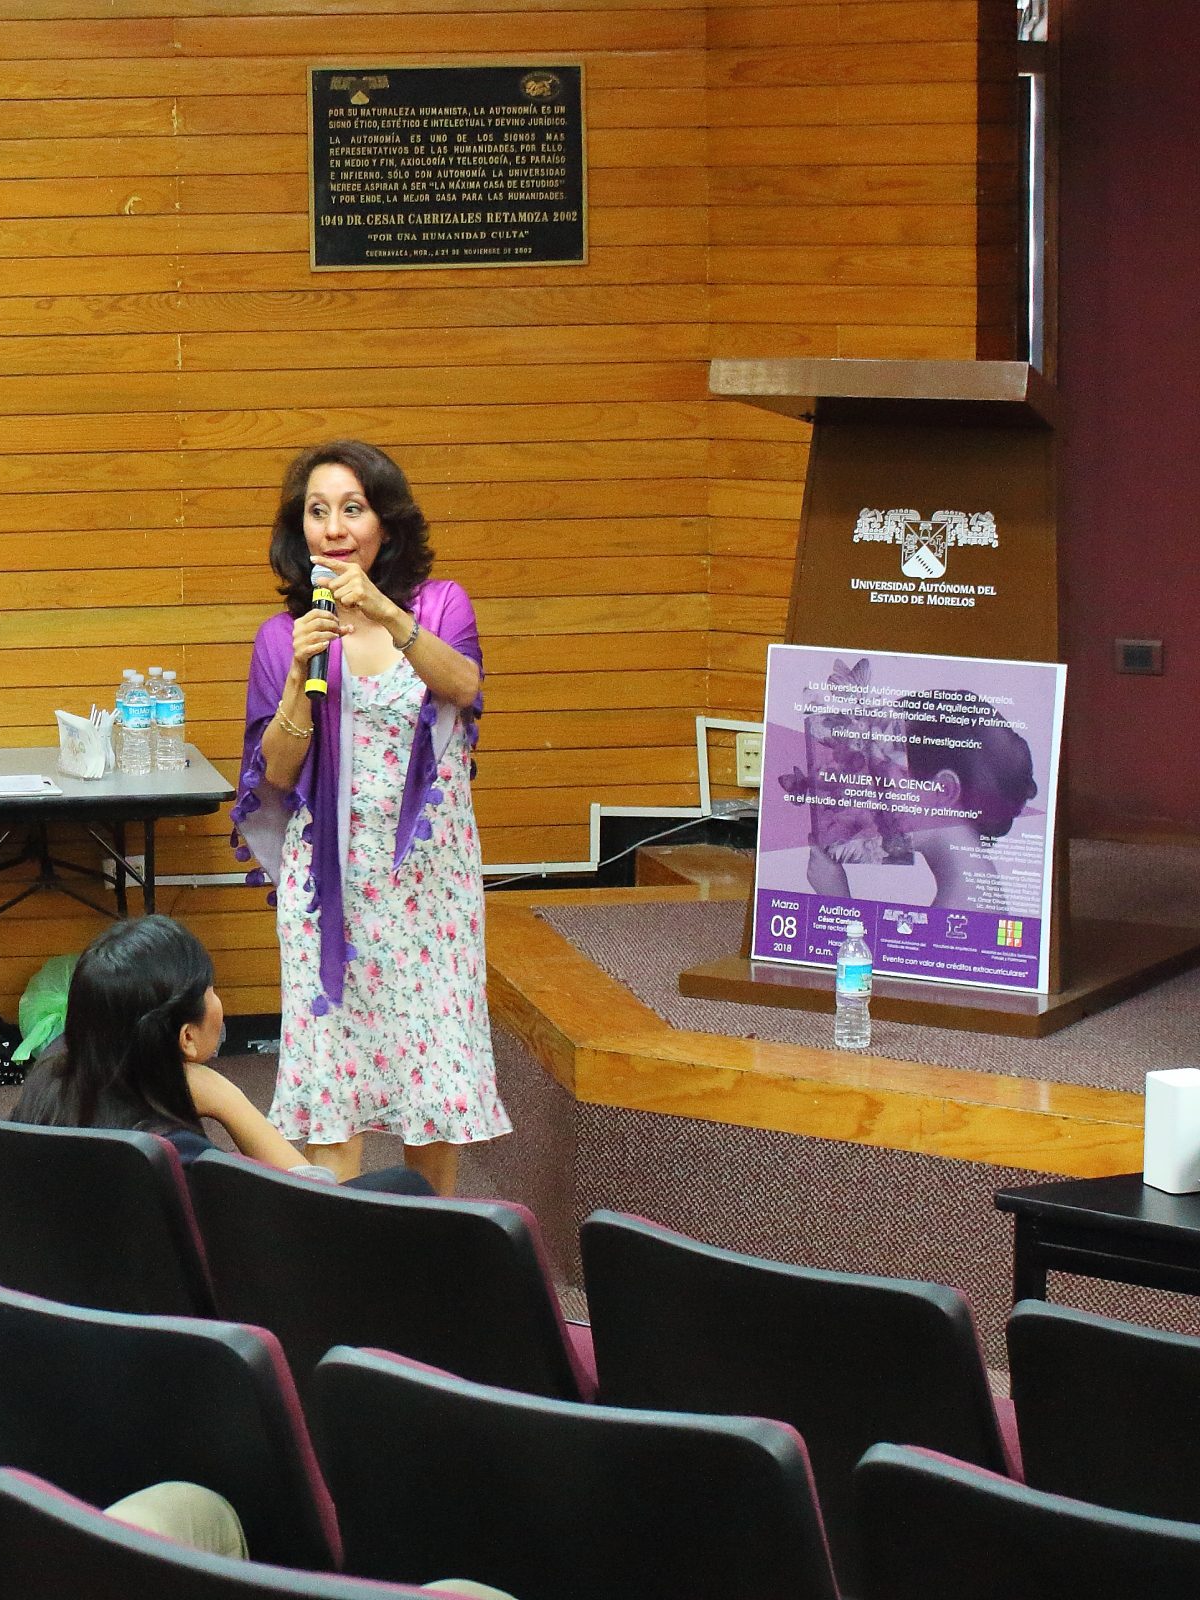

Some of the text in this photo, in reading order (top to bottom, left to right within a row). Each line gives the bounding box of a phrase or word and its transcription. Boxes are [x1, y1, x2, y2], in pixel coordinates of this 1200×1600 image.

[329, 108, 344, 117] POR
[348, 108, 358, 117] SU
[360, 107, 416, 116] NATURALEZA
[474, 106, 485, 115] LA
[490, 104, 538, 115] AUTONOMÍA
[542, 106, 551, 115] ES
[554, 106, 566, 114] UN
[329, 120, 351, 129] SIGNO
[381, 118, 420, 128] ESTÉTICO
[423, 120, 428, 128] E
[431, 118, 485, 128] INTELECTUAL
[488, 118, 493, 127] Y
[495, 118, 526, 127] DEVINO
[330, 136, 341, 145] LA
[350, 132, 401, 144] AUTONOMÍA
[410, 134, 422, 143] ES
[430, 134, 448, 143] UNO
[457, 134, 467, 142] DE
[477, 133, 494, 142] LOS
[504, 133, 536, 142] SIGNOS
[330, 146, 409, 156] REPRESENTATIVOS
[414, 146, 425, 155] DE
[431, 146, 448, 154] LAS
[520, 144, 536, 153] POR
[330, 160, 341, 168] EN
[345, 159, 370, 168] MEDIO
[372, 158, 377, 167] Y
[401, 155, 446, 166] AXIOLOGÍA
[449, 158, 454, 166] Y
[516, 156, 527, 164] ES
[531, 154, 566, 164] PARAÍSO
[330, 172, 336, 180] E
[388, 170, 410, 179] SÓLO
[415, 170, 432, 179] CON
[437, 167, 486, 179] AUTONOMÍA
[493, 169, 504, 178] LA
[509, 168, 566, 177] UNIVERSIDAD
[330, 183, 362, 192] MERECE
[365, 182, 399, 191] ASPIRAR
[402, 182, 408, 191] A
[411, 182, 427, 190] SER
[449, 178, 481, 190] MÁXIMA
[484, 180, 504, 189] CASA
[508, 180, 518, 189] DE
[331, 195, 336, 204] Y
[340, 195, 356, 203] POR
[387, 194, 398, 203] LA
[404, 194, 430, 203] MEJOR
[436, 193, 457, 202] CASA
[462, 193, 483, 201] PARA
[488, 192, 504, 201] LAS
[321, 215, 343, 226] 1949
[366, 214, 405, 225] CESAR
[408, 212, 482, 225] CARRIZALES
[487, 212, 549, 224] RETAMOZA
[553, 211, 578, 222] 2002
[397, 233, 418, 241] UNA
[422, 232, 486, 241] HUMANIDAD
[851, 579, 997, 596] UNIVERSIDAD AUTÓNOMA DEL
[870, 592, 976, 607] ESTADO DE MORELOS
[809, 681, 819, 690] La
[821, 682, 869, 694] Universidad
[871, 686, 916, 698] Autónoma
[918, 688, 933, 698] del
[934, 690, 963, 701] Estado
[965, 692, 977, 702] de
[832, 693, 858, 705] través
[859, 698, 871, 706] de
[872, 698, 881, 706] la
[883, 698, 921, 710] Facultad
[923, 701, 935, 710] de
[936, 702, 990, 715] Arquitectura
[992, 708, 998, 717] y
[794, 702, 802, 711] la
[804, 704, 839, 715] Maestría
[842, 707, 853, 715] en
[854, 708, 888, 719] Estudios
[940, 714, 970, 726] Paisaje
[971, 718, 977, 727] y
[832, 728, 860, 739] invitan
[862, 731, 871, 740] al
[909, 735, 921, 744] de
[840, 774, 872, 786] MUJER
[875, 776, 882, 786] Y
[884, 777, 896, 788] LA
[899, 778, 945, 793] CIENCIA:
[844, 788, 920, 802] aportes y desafíos
[784, 794, 795, 802] en
[797, 794, 805, 803] el
[806, 794, 836, 806] estudio
[838, 798, 852, 808] del
[892, 804, 922, 816] paisaje
[924, 808, 930, 817] y
[772, 899, 800, 911] Marzo
[819, 905, 861, 918] Auditorio
[771, 915, 797, 939] 08
[774, 943, 792, 953] 2018
[809, 945, 814, 954] 9
[883, 955, 905, 964] Evento
[919, 960, 935, 968] valor
[946, 962, 972, 972] créditos
